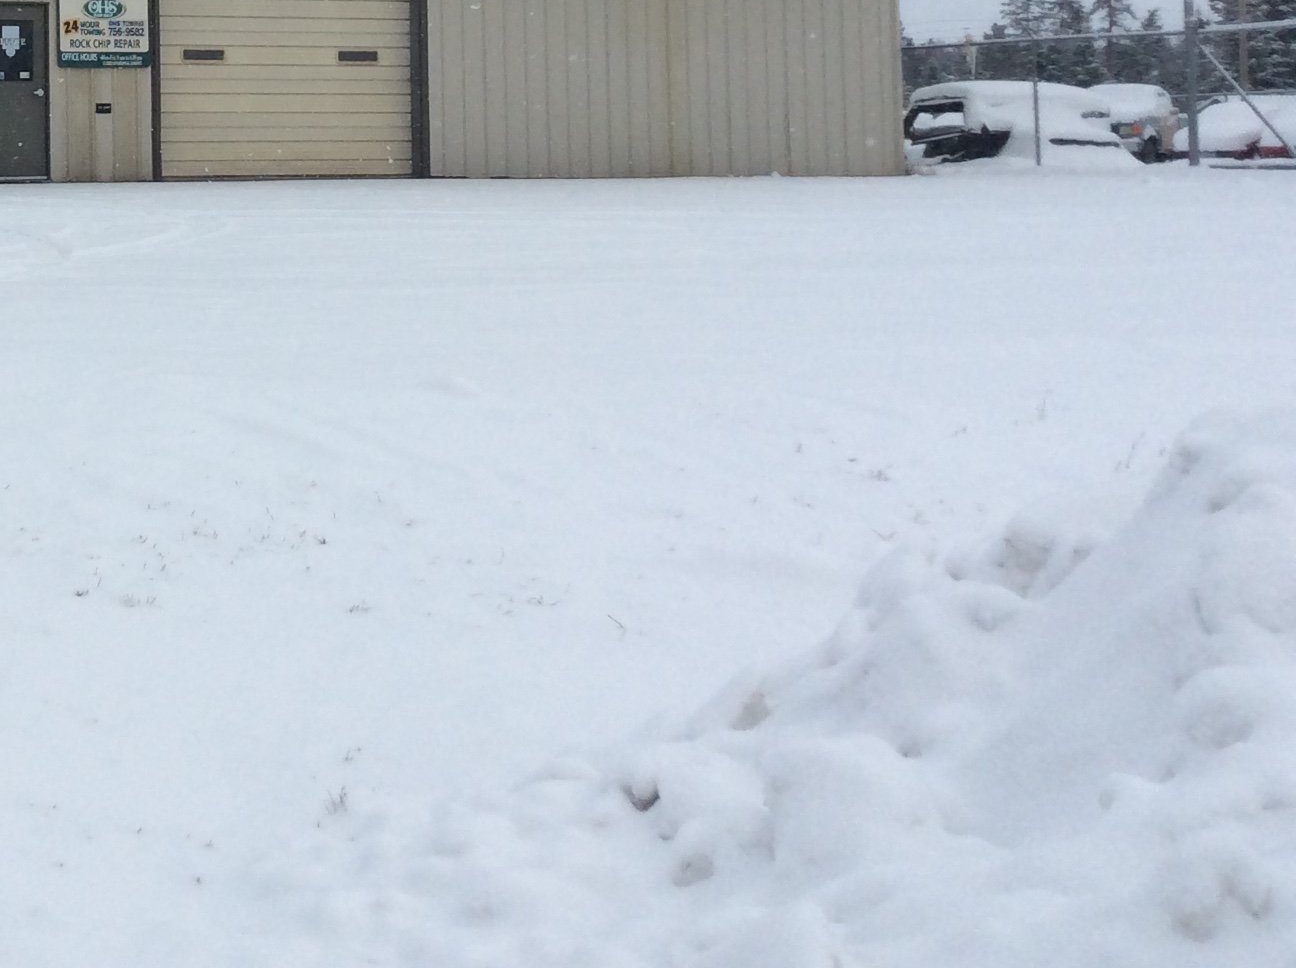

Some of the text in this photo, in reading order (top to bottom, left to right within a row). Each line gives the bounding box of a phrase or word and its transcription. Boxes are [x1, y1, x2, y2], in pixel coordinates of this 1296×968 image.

[63, 20, 80, 34] 24
[80, 28, 106, 36] TOWING
[69, 39, 141, 49] ROCK CHIP REPAIR
[61, 52, 80, 61] OFFICE
[80, 52, 98, 62] HOURS
